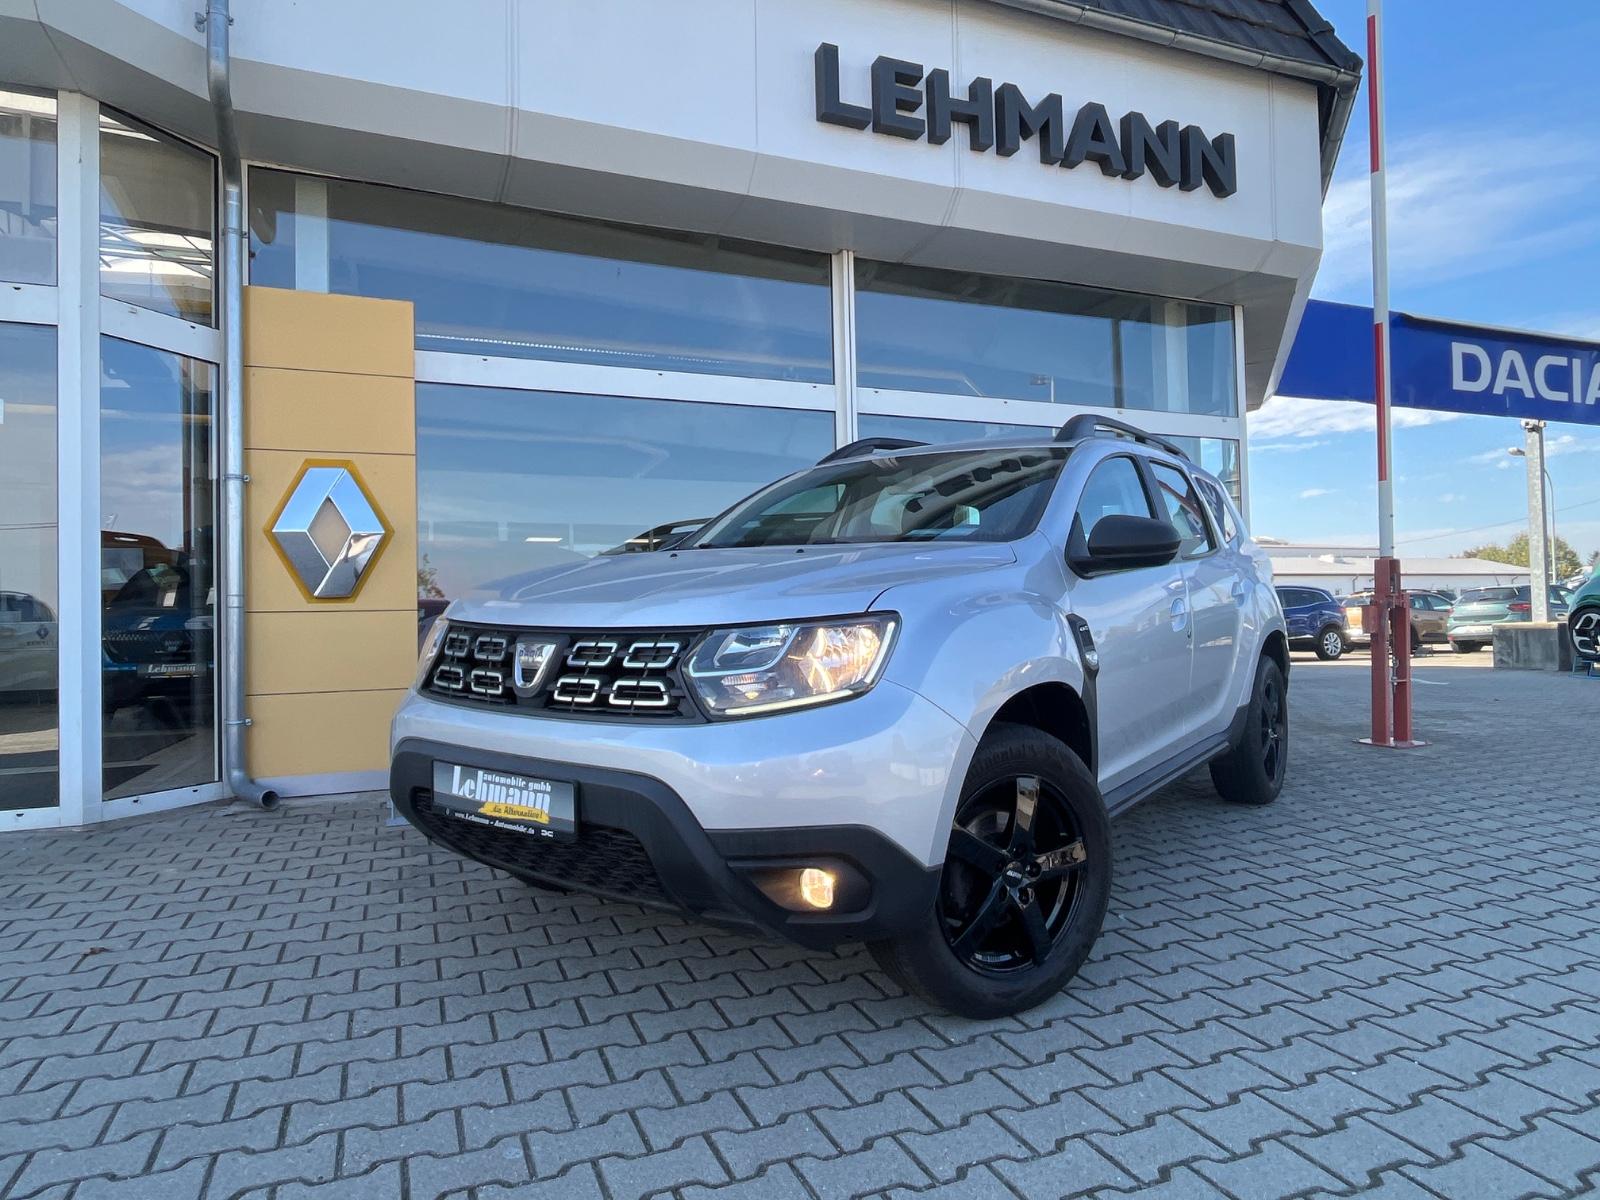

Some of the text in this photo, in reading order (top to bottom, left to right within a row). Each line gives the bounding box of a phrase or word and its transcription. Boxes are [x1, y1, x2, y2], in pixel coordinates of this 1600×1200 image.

[815, 42, 1237, 198] LEHMANN
[148, 664, 196, 673] Lehmann
[452, 765, 550, 814] Lehmann
[483, 773, 552, 792] automobile gmbh
